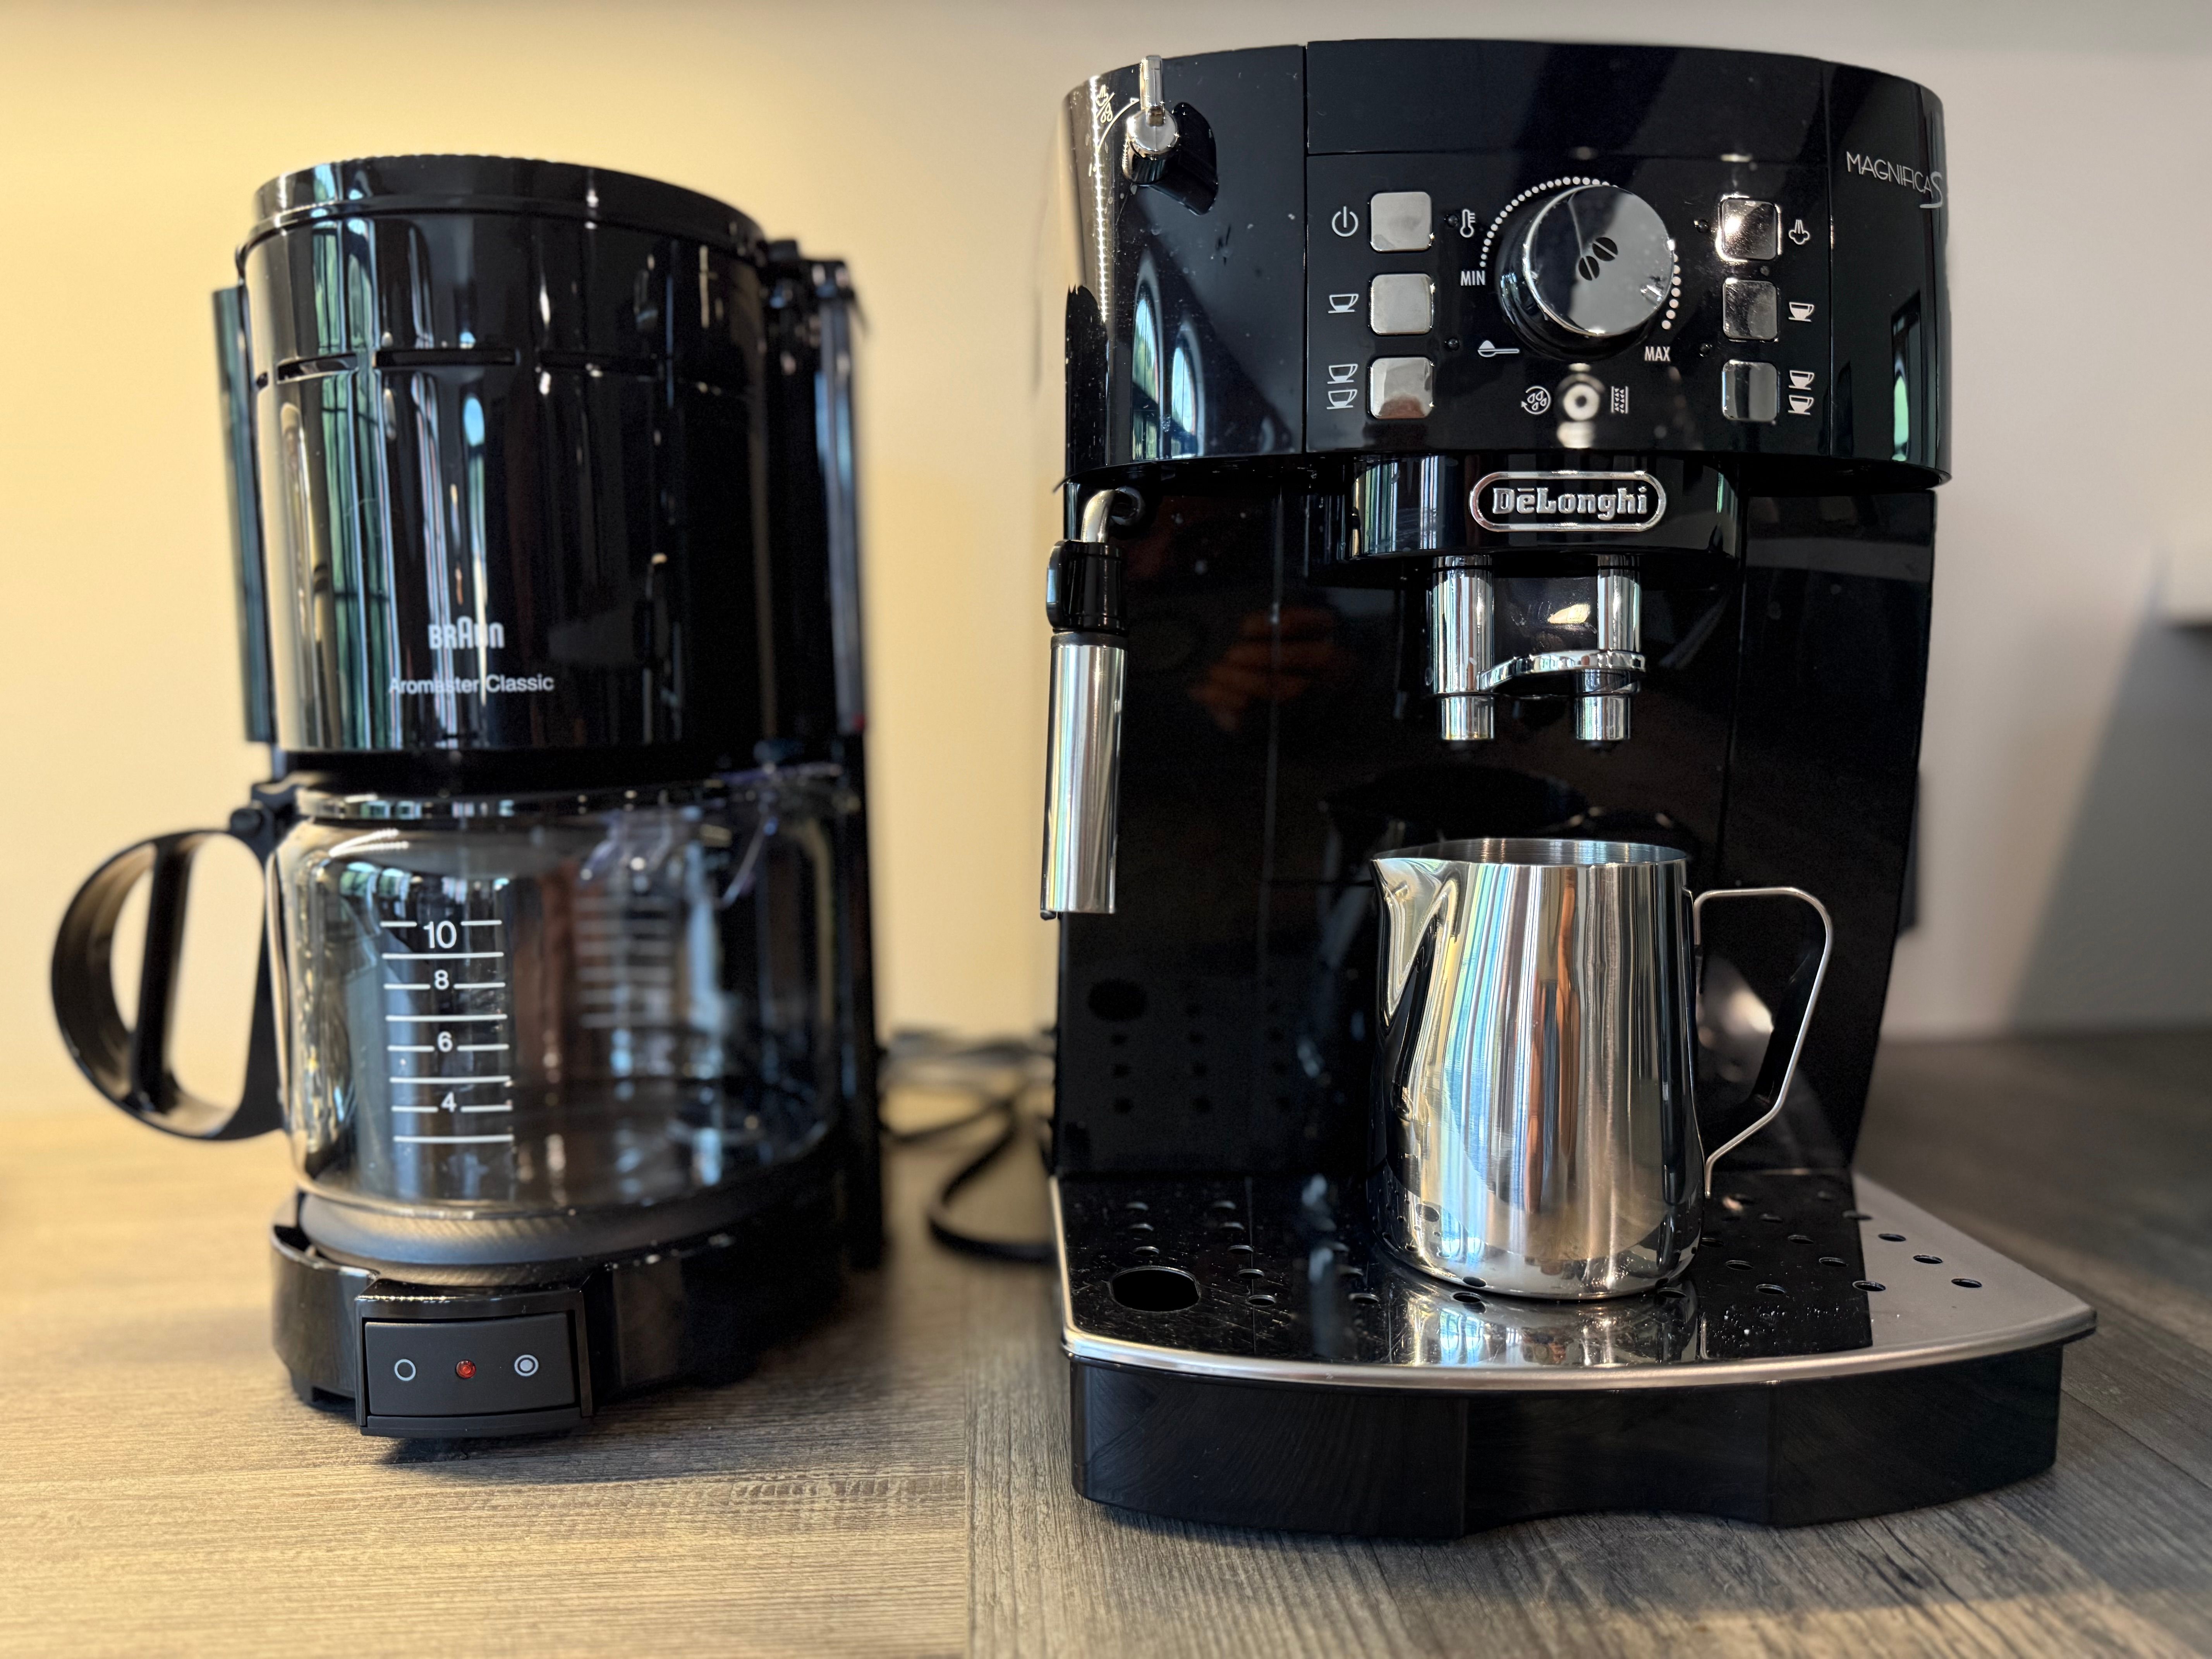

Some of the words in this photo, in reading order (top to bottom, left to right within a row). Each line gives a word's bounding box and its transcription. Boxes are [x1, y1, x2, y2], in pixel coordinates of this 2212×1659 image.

[1846, 151, 1934, 199] MAGNIFICA
[1460, 270, 1486, 286] MIN
[1644, 346, 1671, 362] MAX
[428, 616, 505, 649] BRAUN
[389, 677, 479, 694] Aromaster
[486, 674, 554, 692] Classic
[423, 921, 457, 949] 10
[434, 970, 449, 990] 8
[437, 1032, 453, 1053] 6
[441, 1092, 457, 1112] 4
